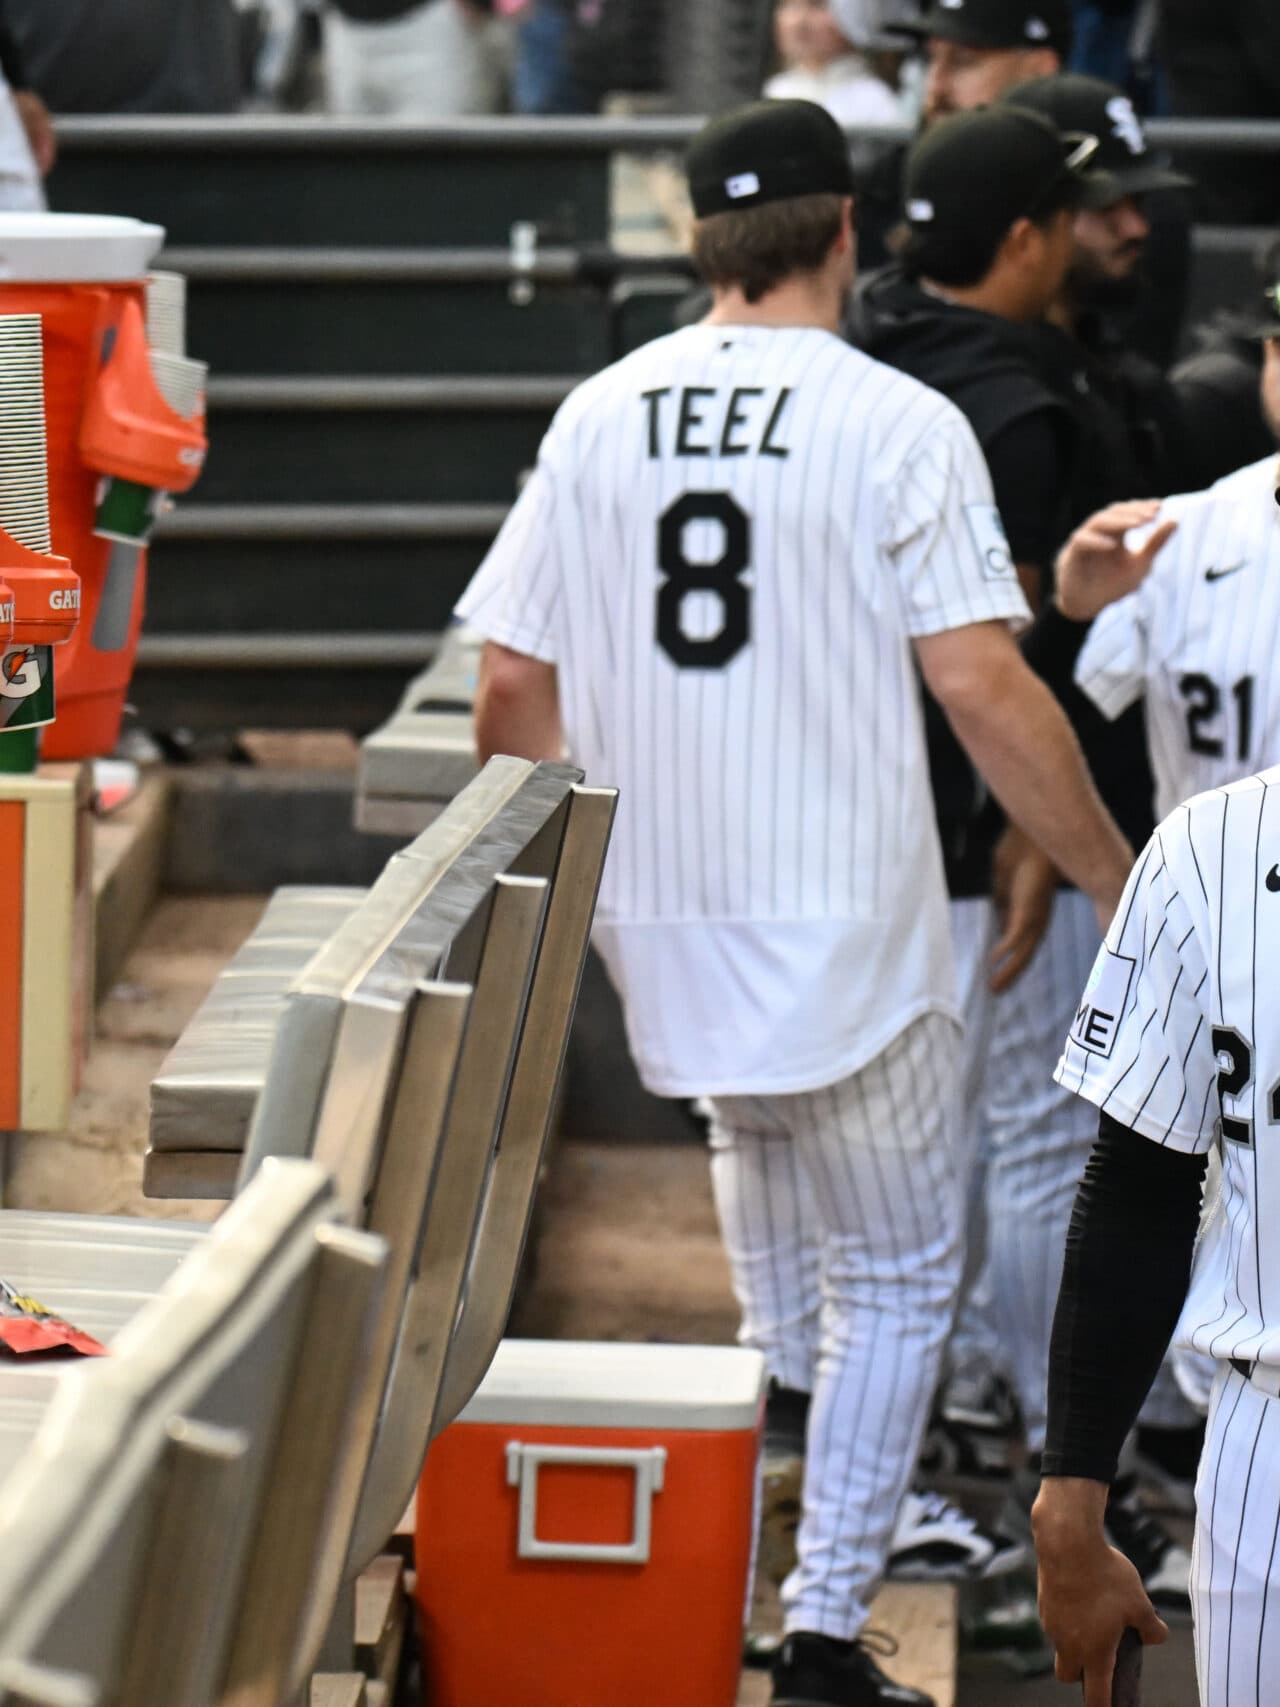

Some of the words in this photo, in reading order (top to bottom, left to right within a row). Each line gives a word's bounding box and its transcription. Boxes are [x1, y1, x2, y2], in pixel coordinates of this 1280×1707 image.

[641, 386, 793, 459] TEEL
[655, 490, 752, 672] 8
[1179, 672, 1254, 762] 21
[1076, 1003, 1115, 1049] ME
